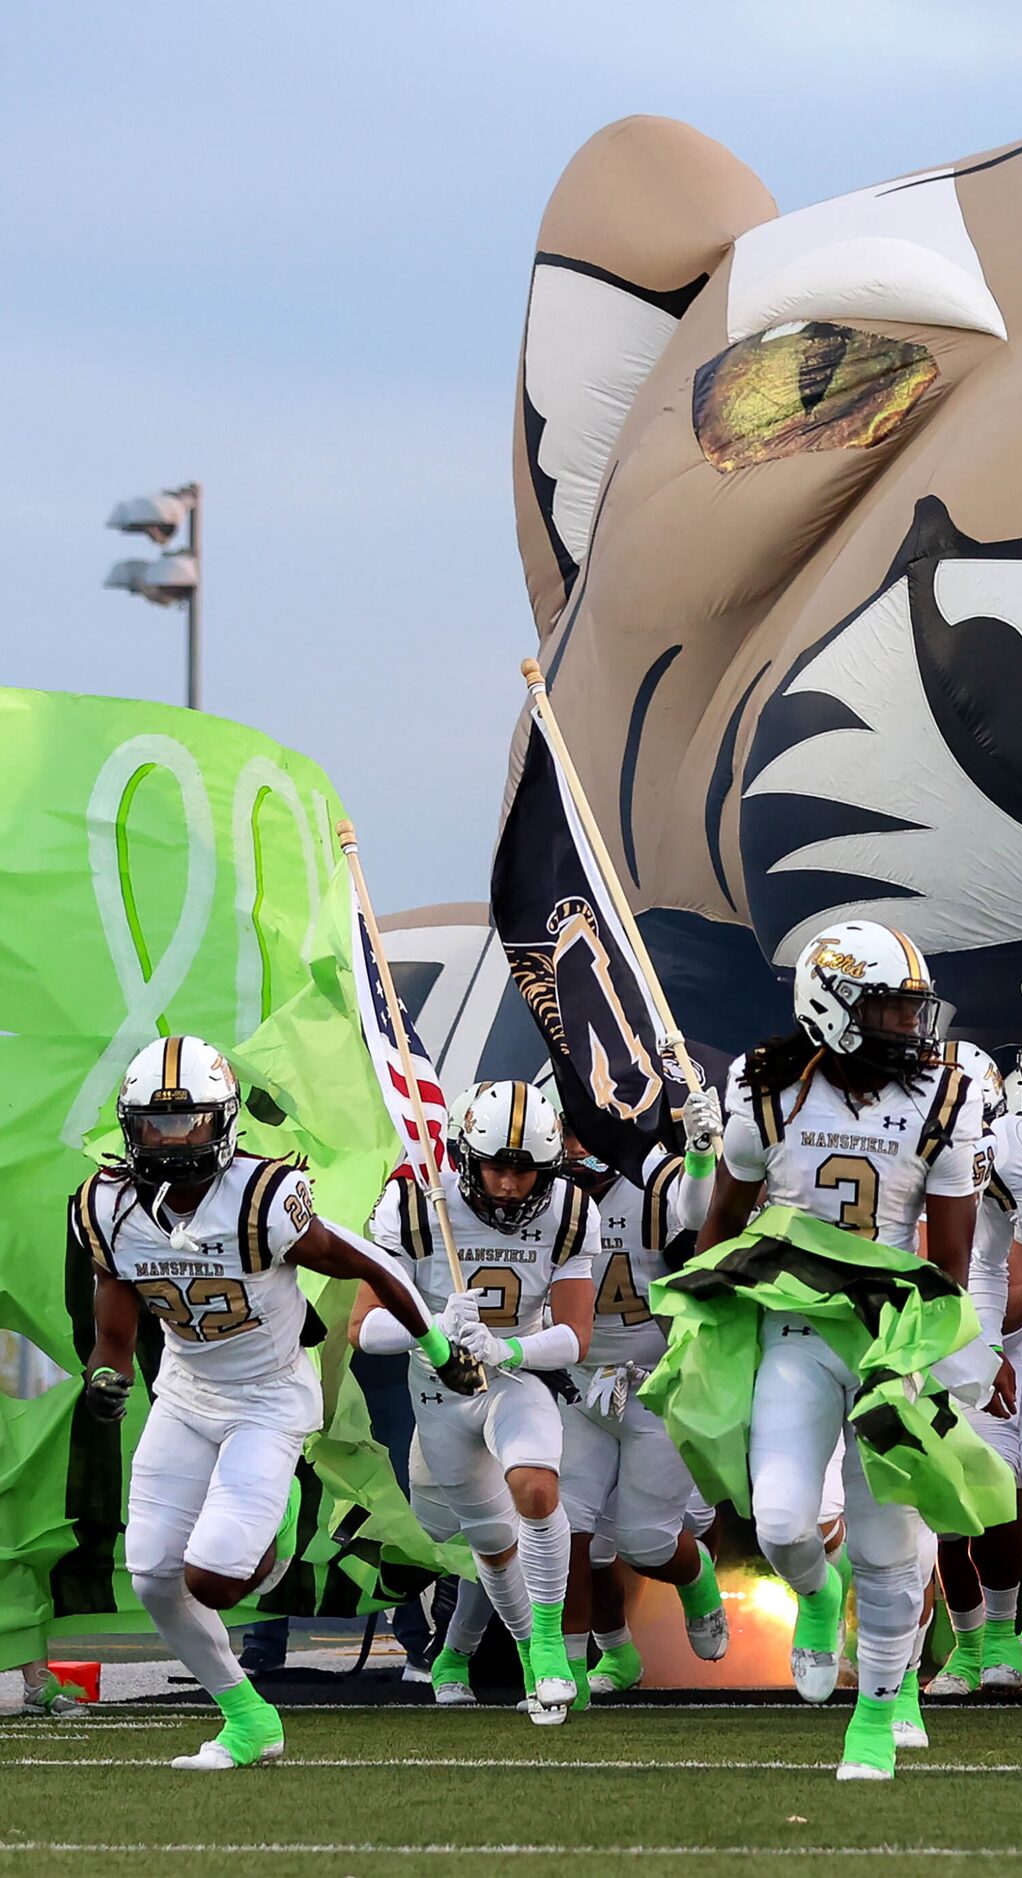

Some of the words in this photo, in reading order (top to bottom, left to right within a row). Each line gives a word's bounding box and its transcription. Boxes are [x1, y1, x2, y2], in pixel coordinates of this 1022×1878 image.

[800, 1131, 899, 1156] MANSFIELD
[815, 1153, 880, 1242] 3
[134, 1262, 225, 1277] MANSFIELD
[467, 1266, 522, 1328] 2
[135, 1277, 264, 1343] 22
